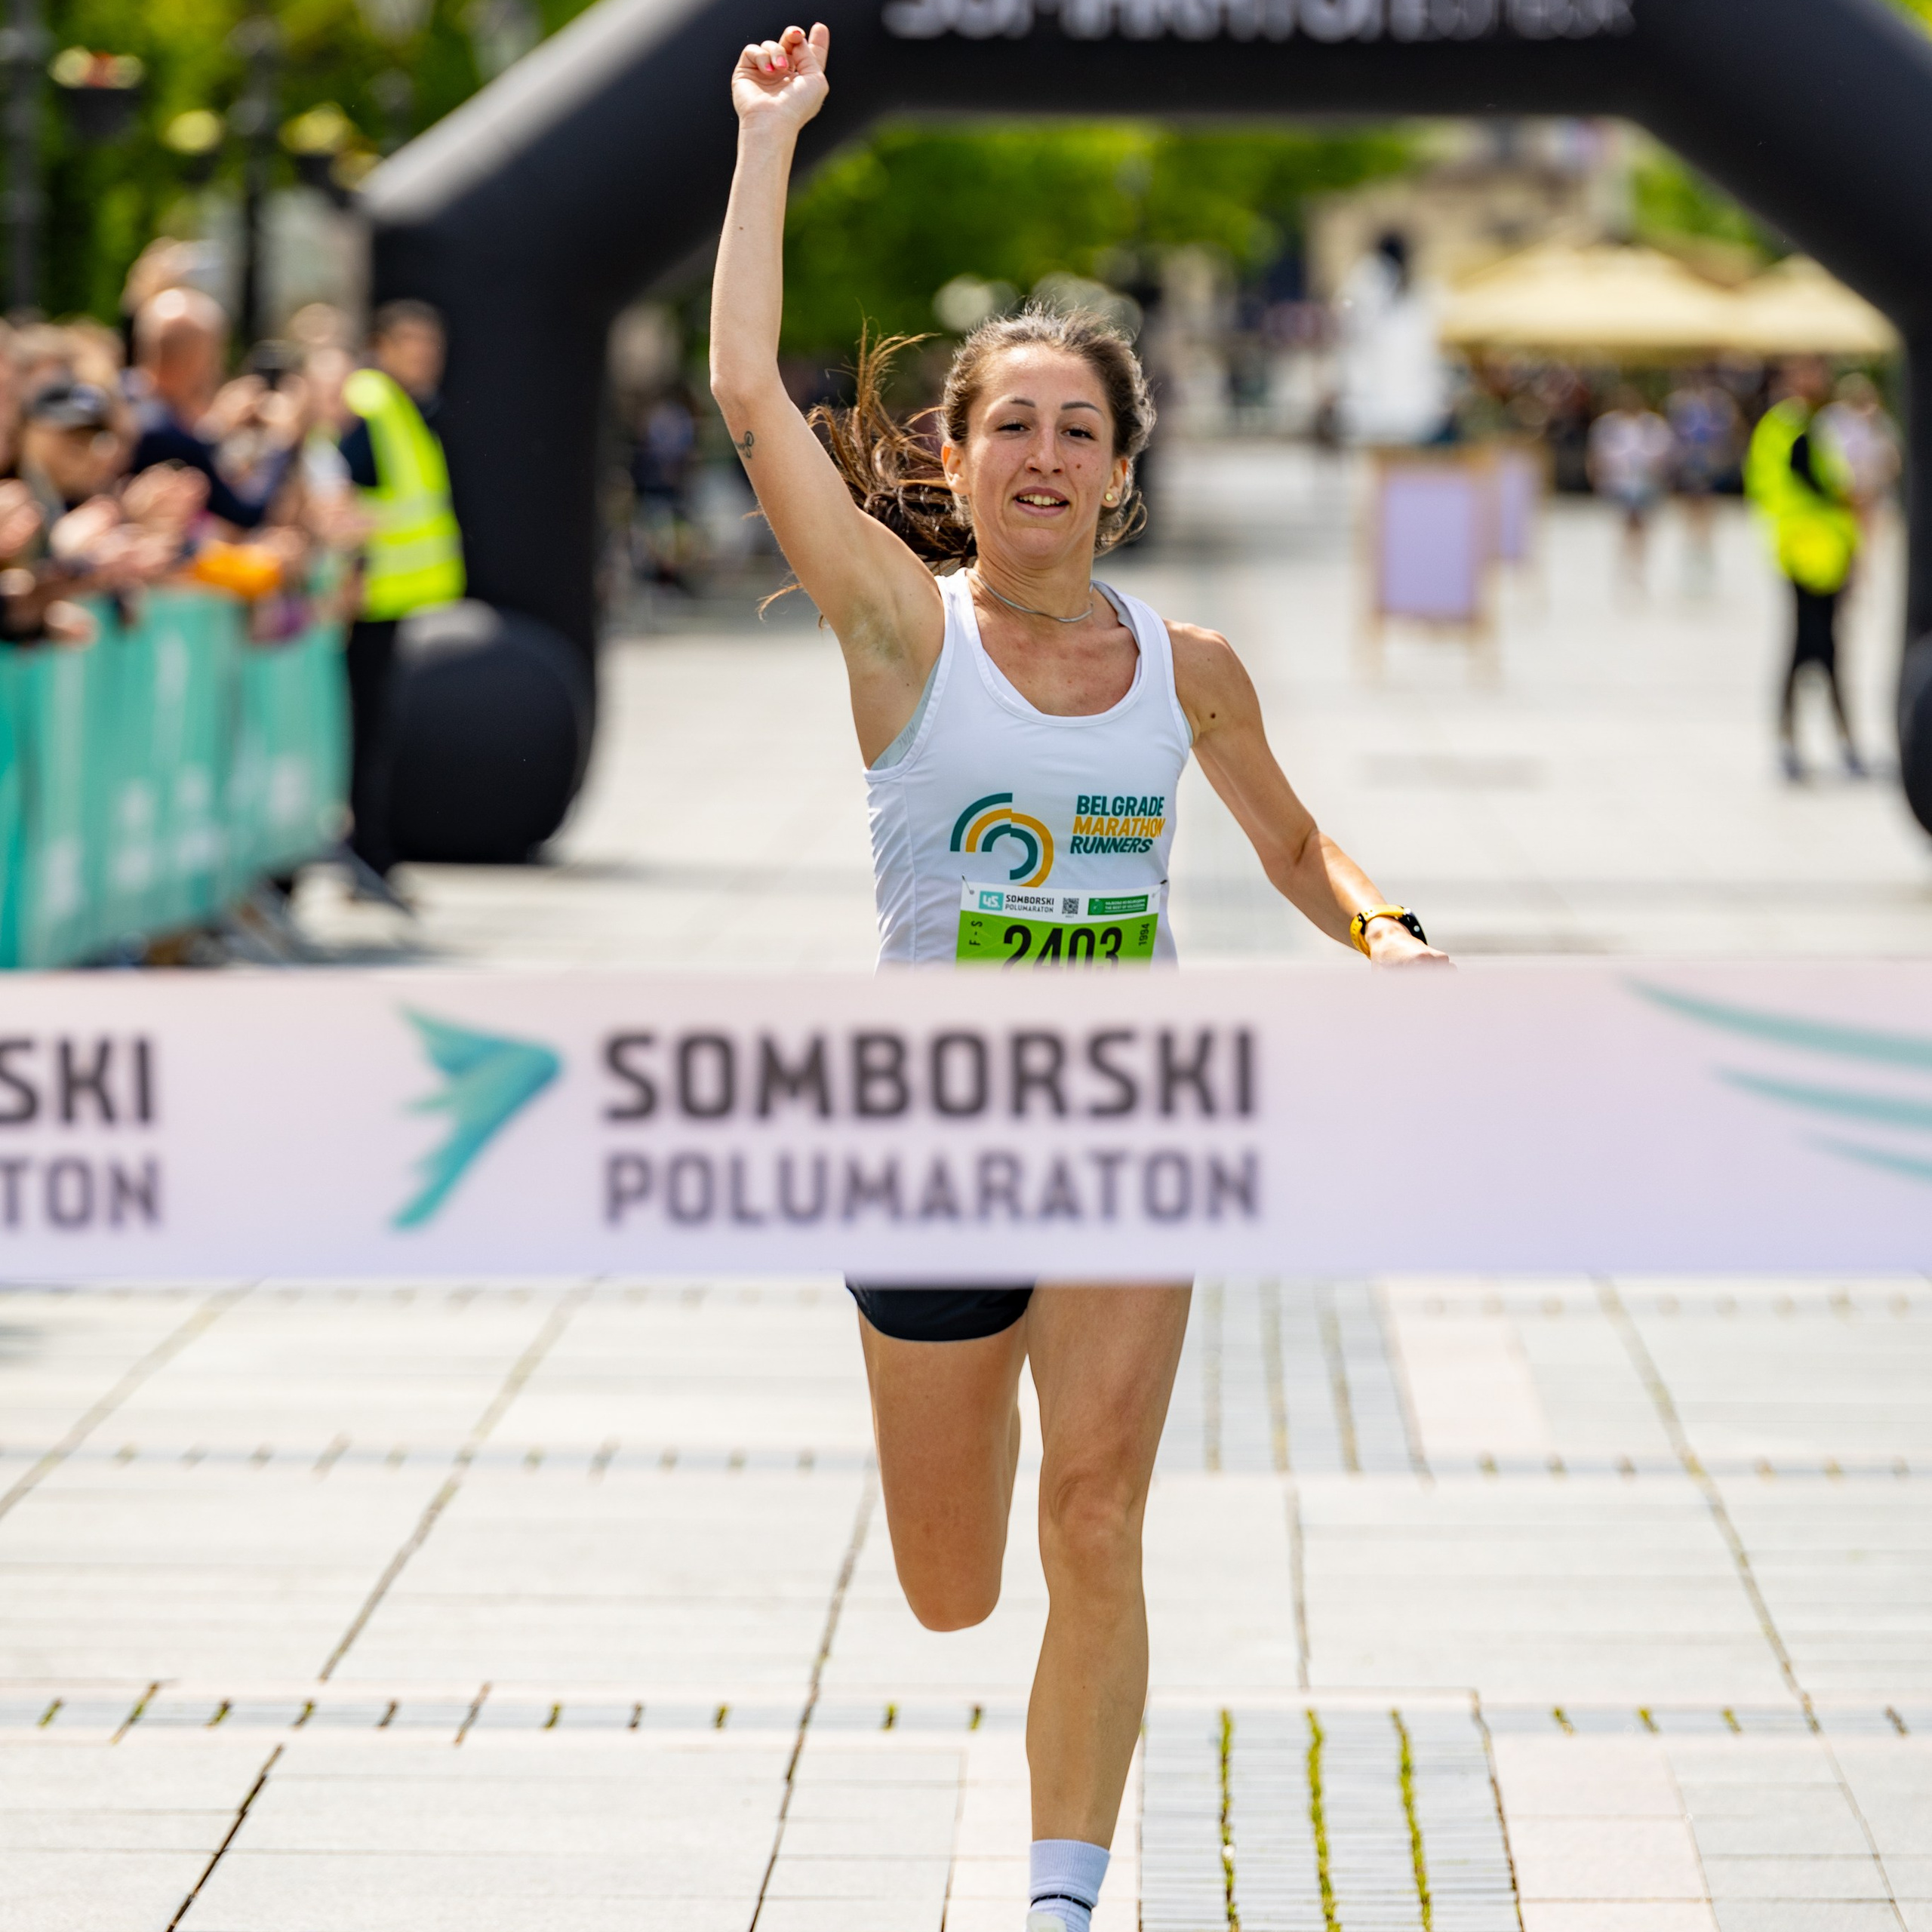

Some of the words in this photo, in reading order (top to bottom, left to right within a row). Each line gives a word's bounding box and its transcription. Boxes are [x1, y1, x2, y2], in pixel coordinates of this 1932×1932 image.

[1076, 795, 1164, 817] BELGRADE
[1072, 816, 1166, 838] MARATHON
[1070, 835, 1153, 854] RUNNERS
[1004, 903, 1054, 912] POLUMARATON
[1005, 894, 1054, 905] SOMBORSKI
[1139, 923, 1150, 946] 1994
[1001, 924, 1122, 972] 2403
[602, 1028, 1257, 1121] SOMBORSKI
[605, 1150, 1259, 1226] POLUMARATON
